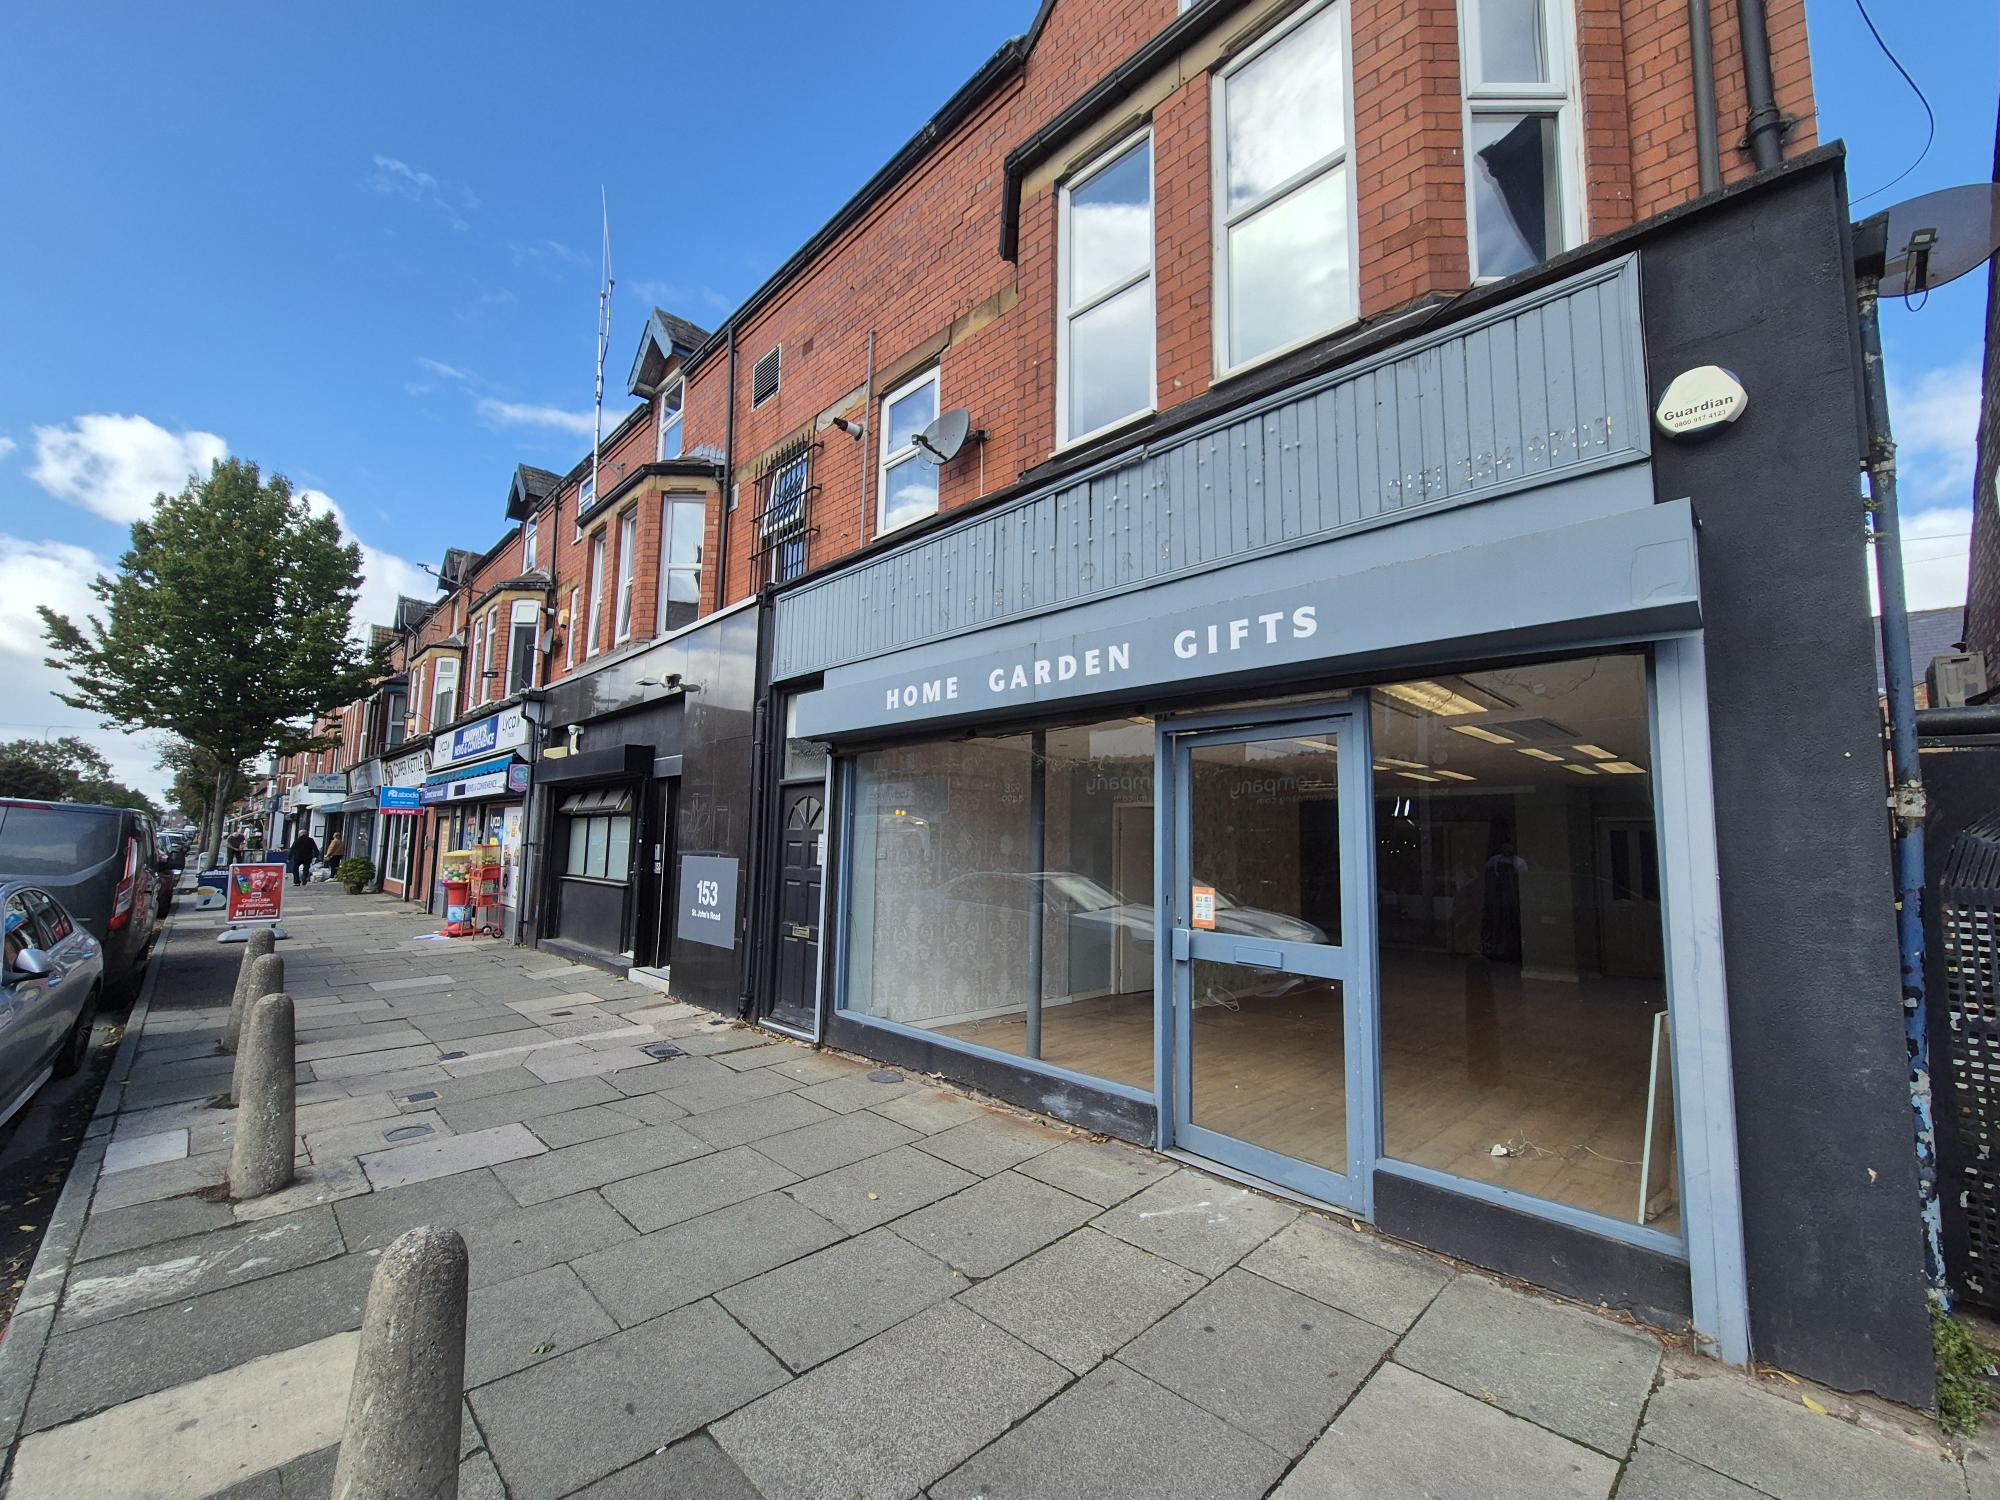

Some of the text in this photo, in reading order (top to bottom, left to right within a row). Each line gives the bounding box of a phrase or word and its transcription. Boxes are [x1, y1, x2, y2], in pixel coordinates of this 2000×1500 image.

[1663, 395, 1734, 421] Guardian
[885, 605, 1319, 711] HOME GARDEN GIFTS
[696, 879, 718, 907] 153
[709, 911, 721, 921] Road
